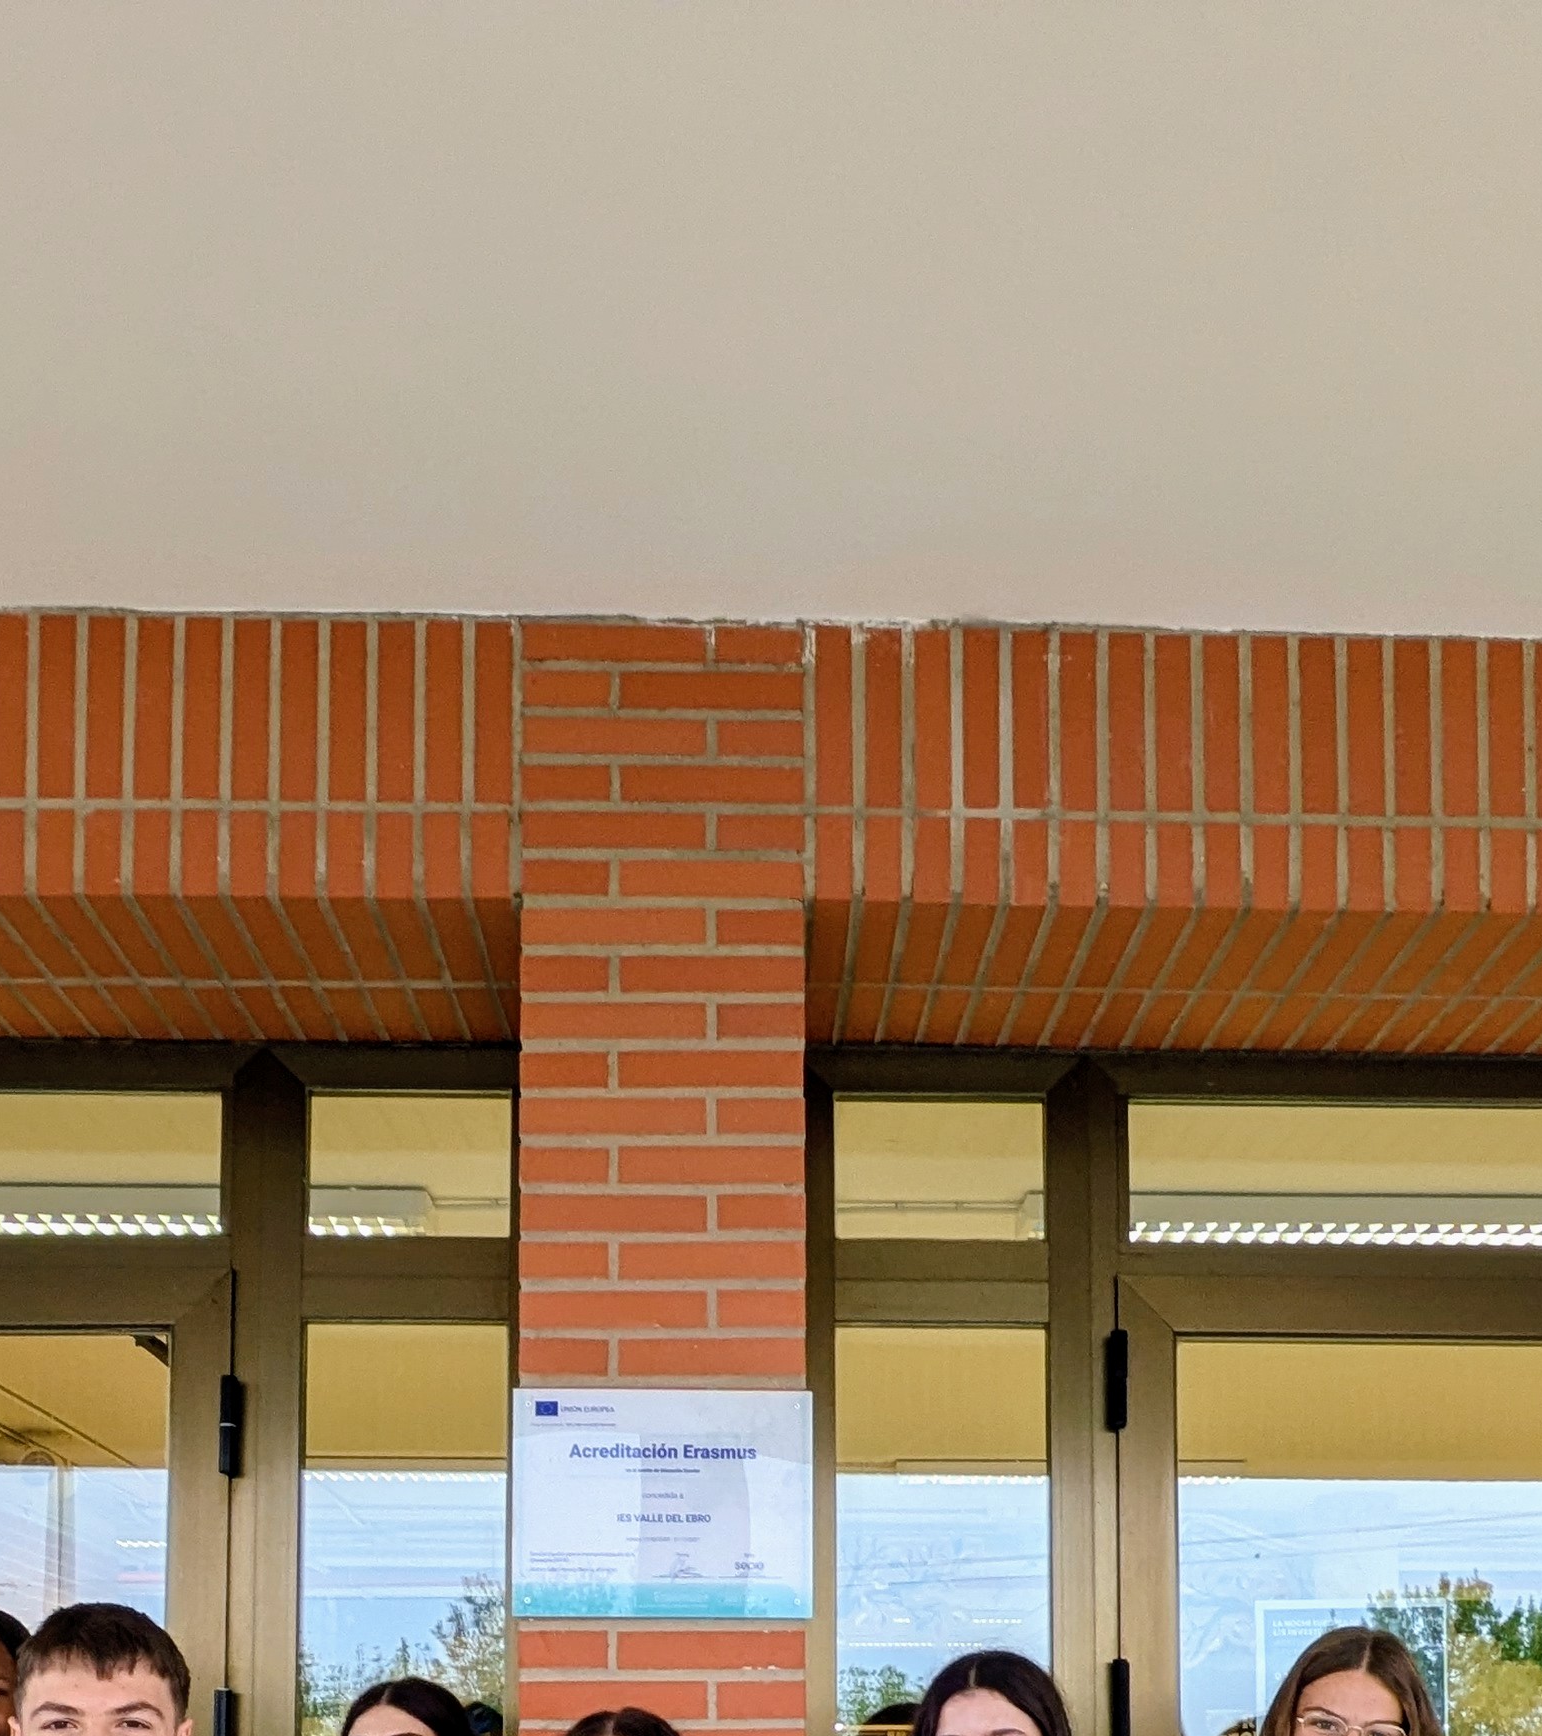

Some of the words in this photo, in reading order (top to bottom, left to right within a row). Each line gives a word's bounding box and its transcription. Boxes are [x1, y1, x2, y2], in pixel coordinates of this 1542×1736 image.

[569, 1443, 678, 1459] Acreditación
[683, 1444, 757, 1460] Erasmus
[617, 1513, 632, 1522] IES
[634, 1513, 663, 1523] VALLE
[665, 1514, 684, 1523] DEL
[686, 1514, 711, 1523] EBRO
